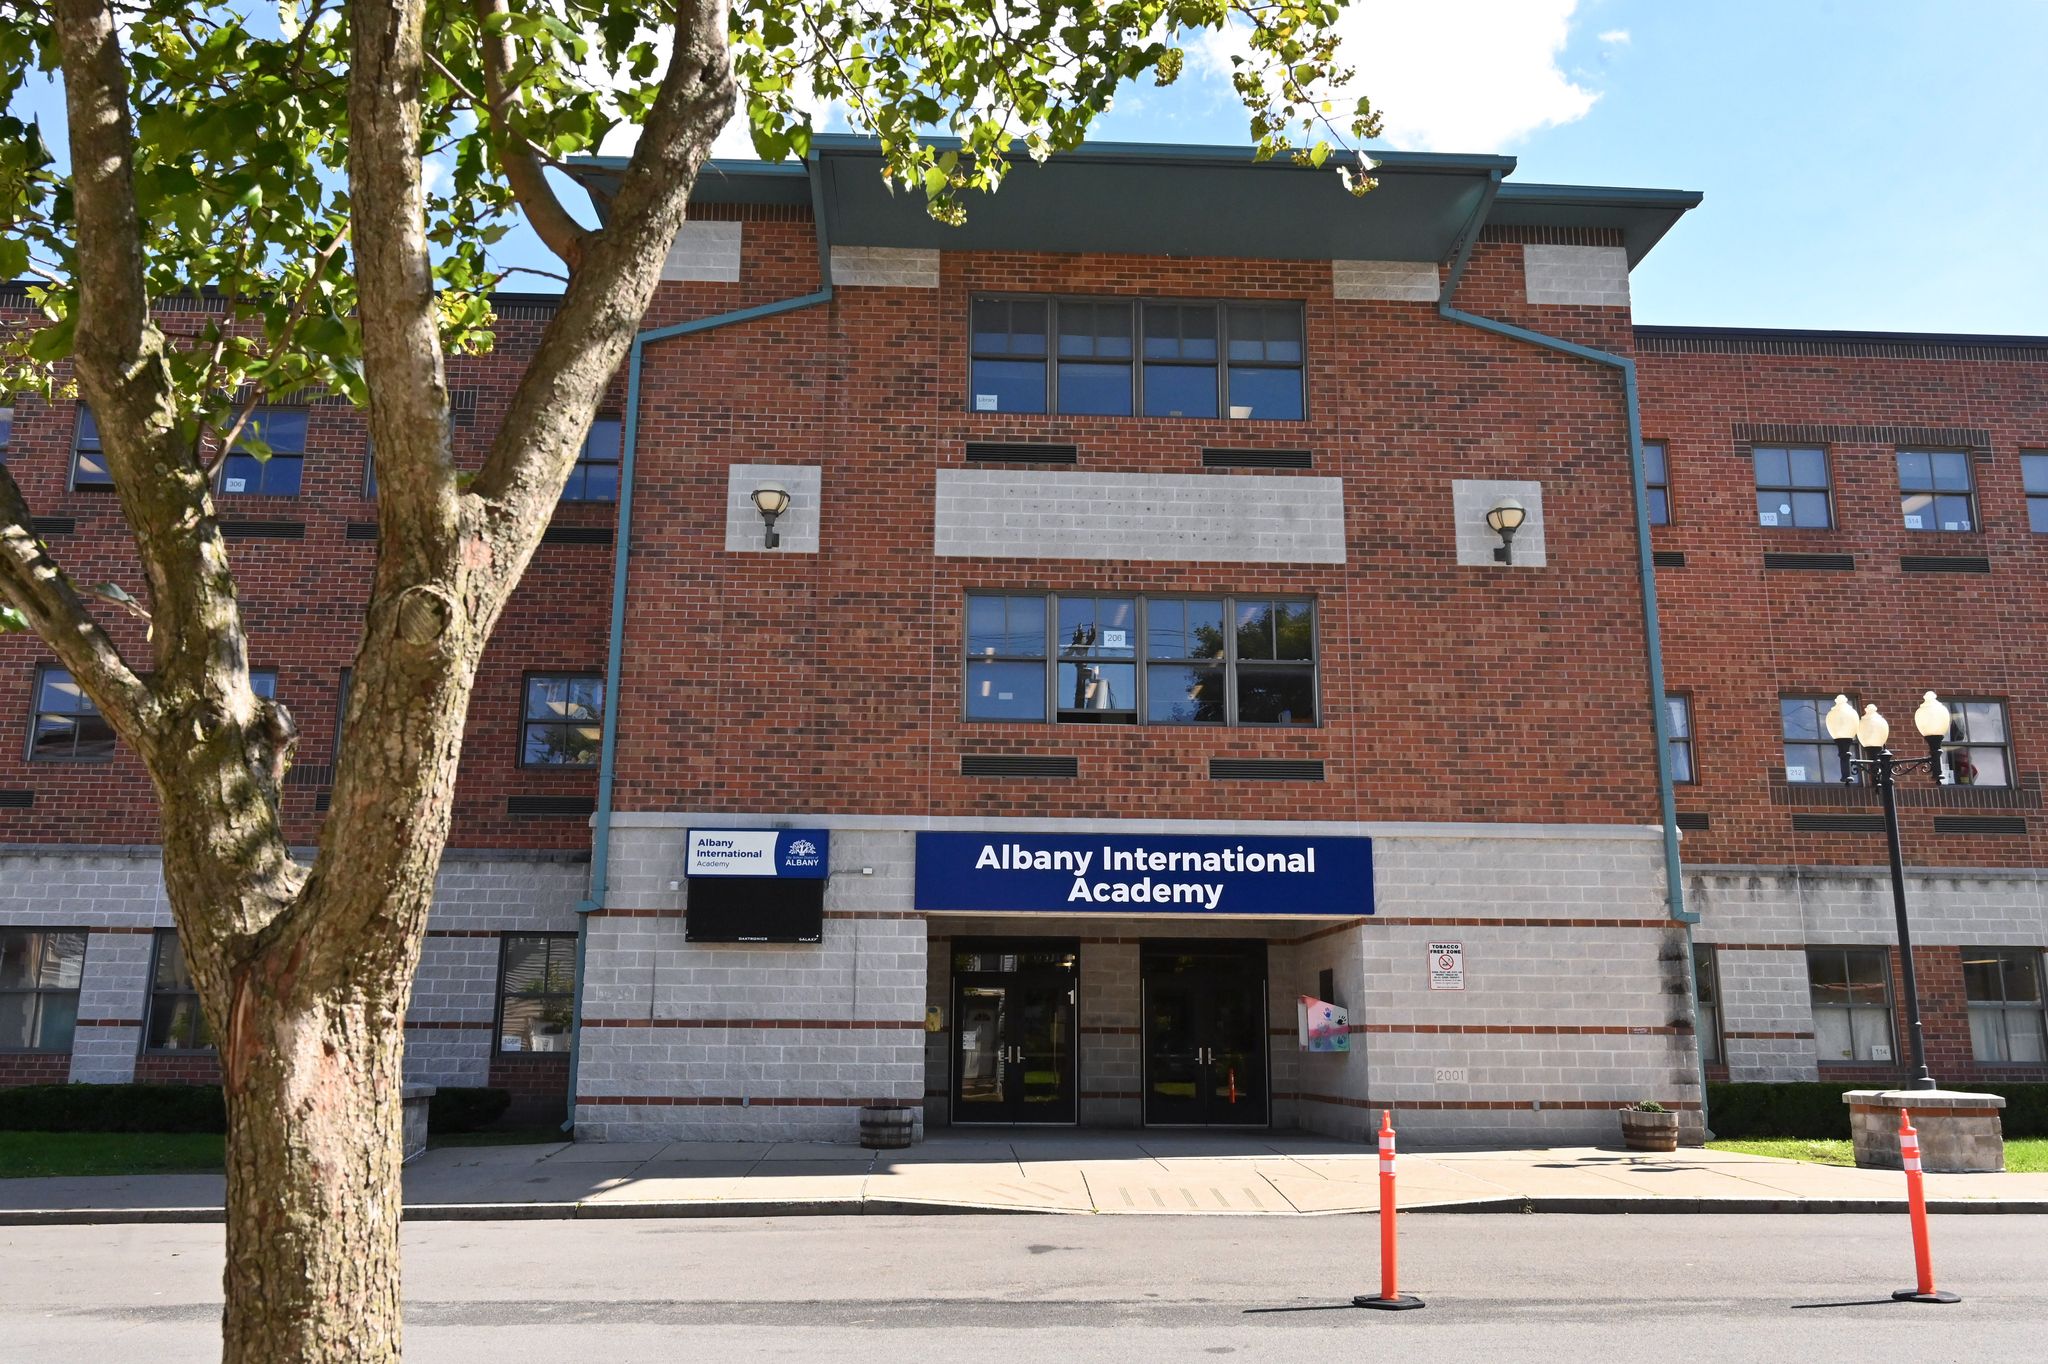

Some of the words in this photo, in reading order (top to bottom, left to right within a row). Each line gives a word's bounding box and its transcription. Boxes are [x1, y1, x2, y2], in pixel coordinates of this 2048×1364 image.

[698, 838, 734, 849] Albany
[697, 849, 762, 858] International
[697, 860, 730, 868] Academy
[975, 844, 1093, 877] Albany
[1103, 845, 1316, 873] International
[1067, 877, 1224, 910] Academy
[1067, 989, 1074, 1005] 1
[1436, 1070, 1464, 1081] 2001
